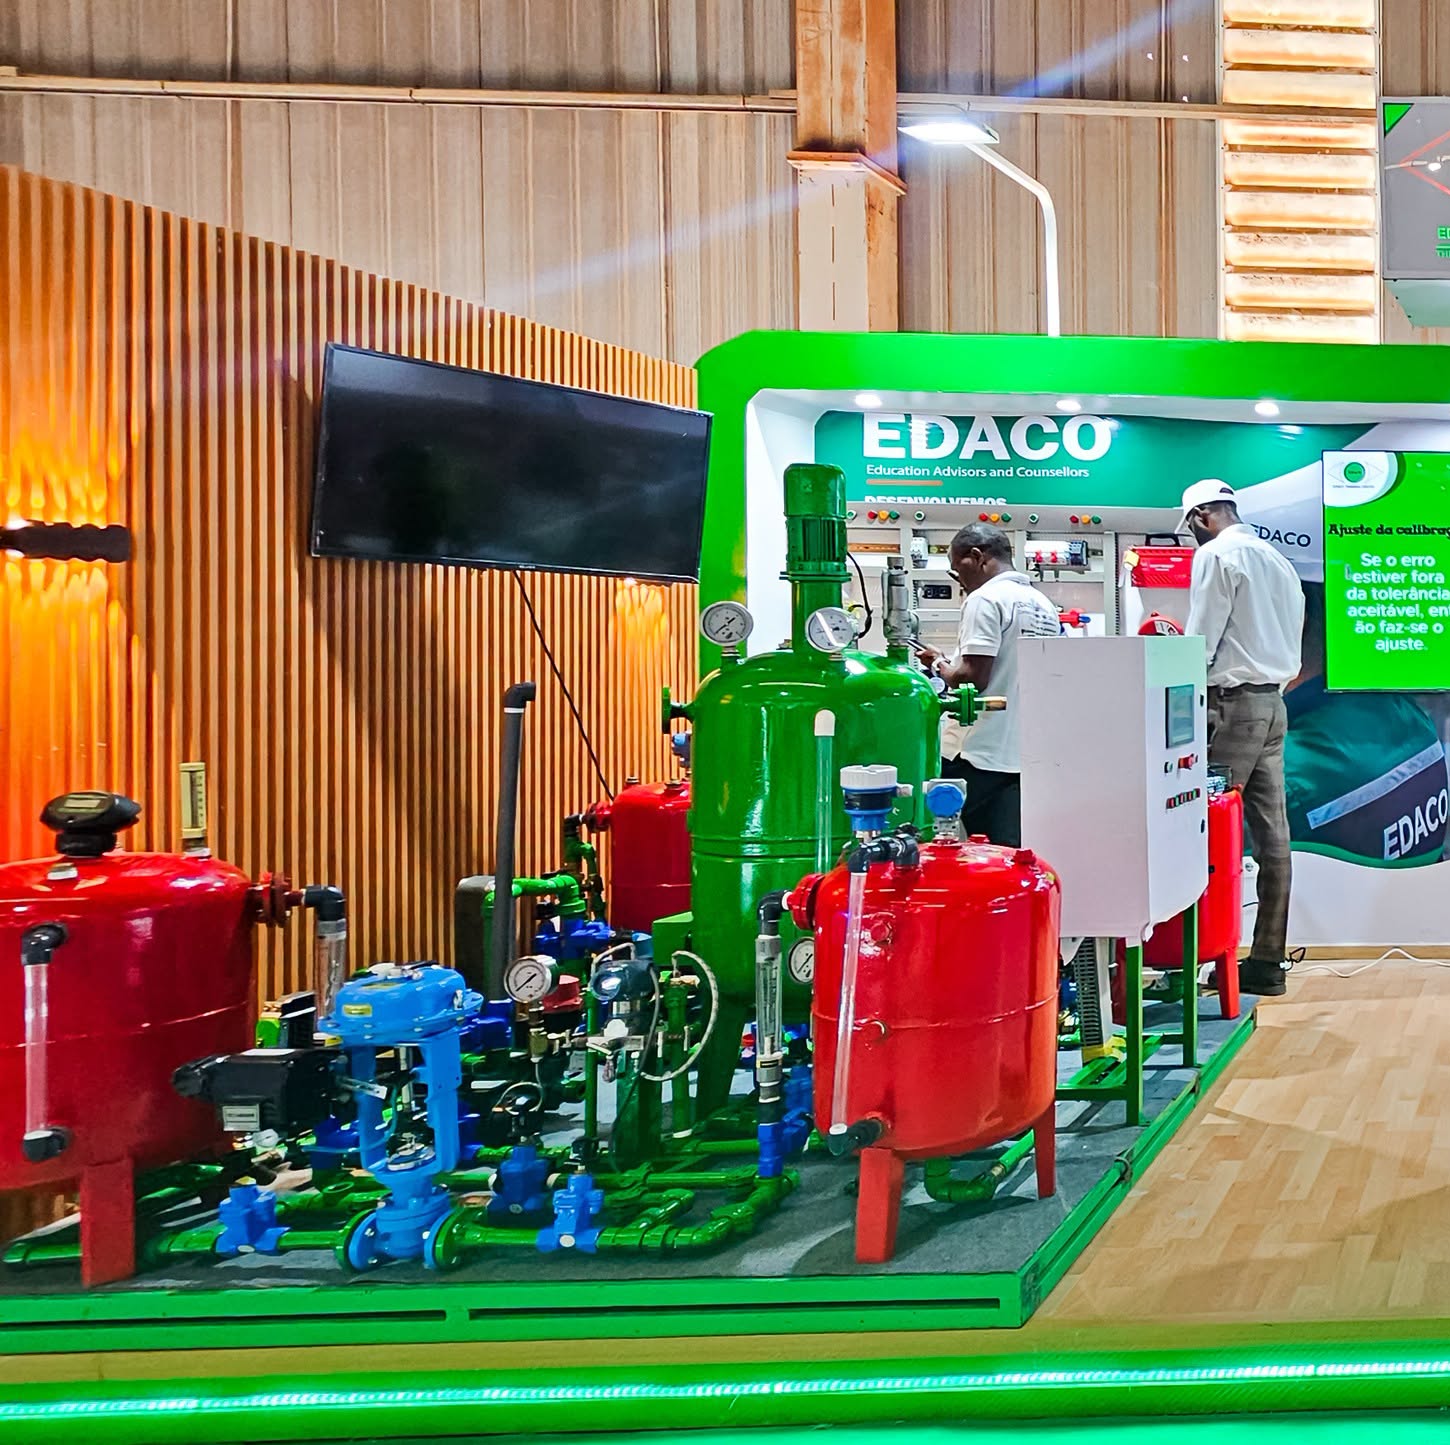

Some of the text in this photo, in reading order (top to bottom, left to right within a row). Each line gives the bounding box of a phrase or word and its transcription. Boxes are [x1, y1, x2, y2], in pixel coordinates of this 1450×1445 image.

[863, 412, 1112, 461] EDACO
[866, 464, 1090, 478] Education Advisors and Counsellors
[1328, 523, 1372, 537] Ajuste
[1375, 524, 1393, 535] da
[1361, 553, 1436, 567] Se o erro
[1352, 569, 1445, 584] estiver fora
[1346, 586, 1450, 601] da tolerância
[1347, 603, 1425, 619] aceitável,
[1355, 619, 1444, 634] ão faz-se o
[1375, 637, 1428, 653] ajuste.
[1384, 788, 1448, 860] EDACO
